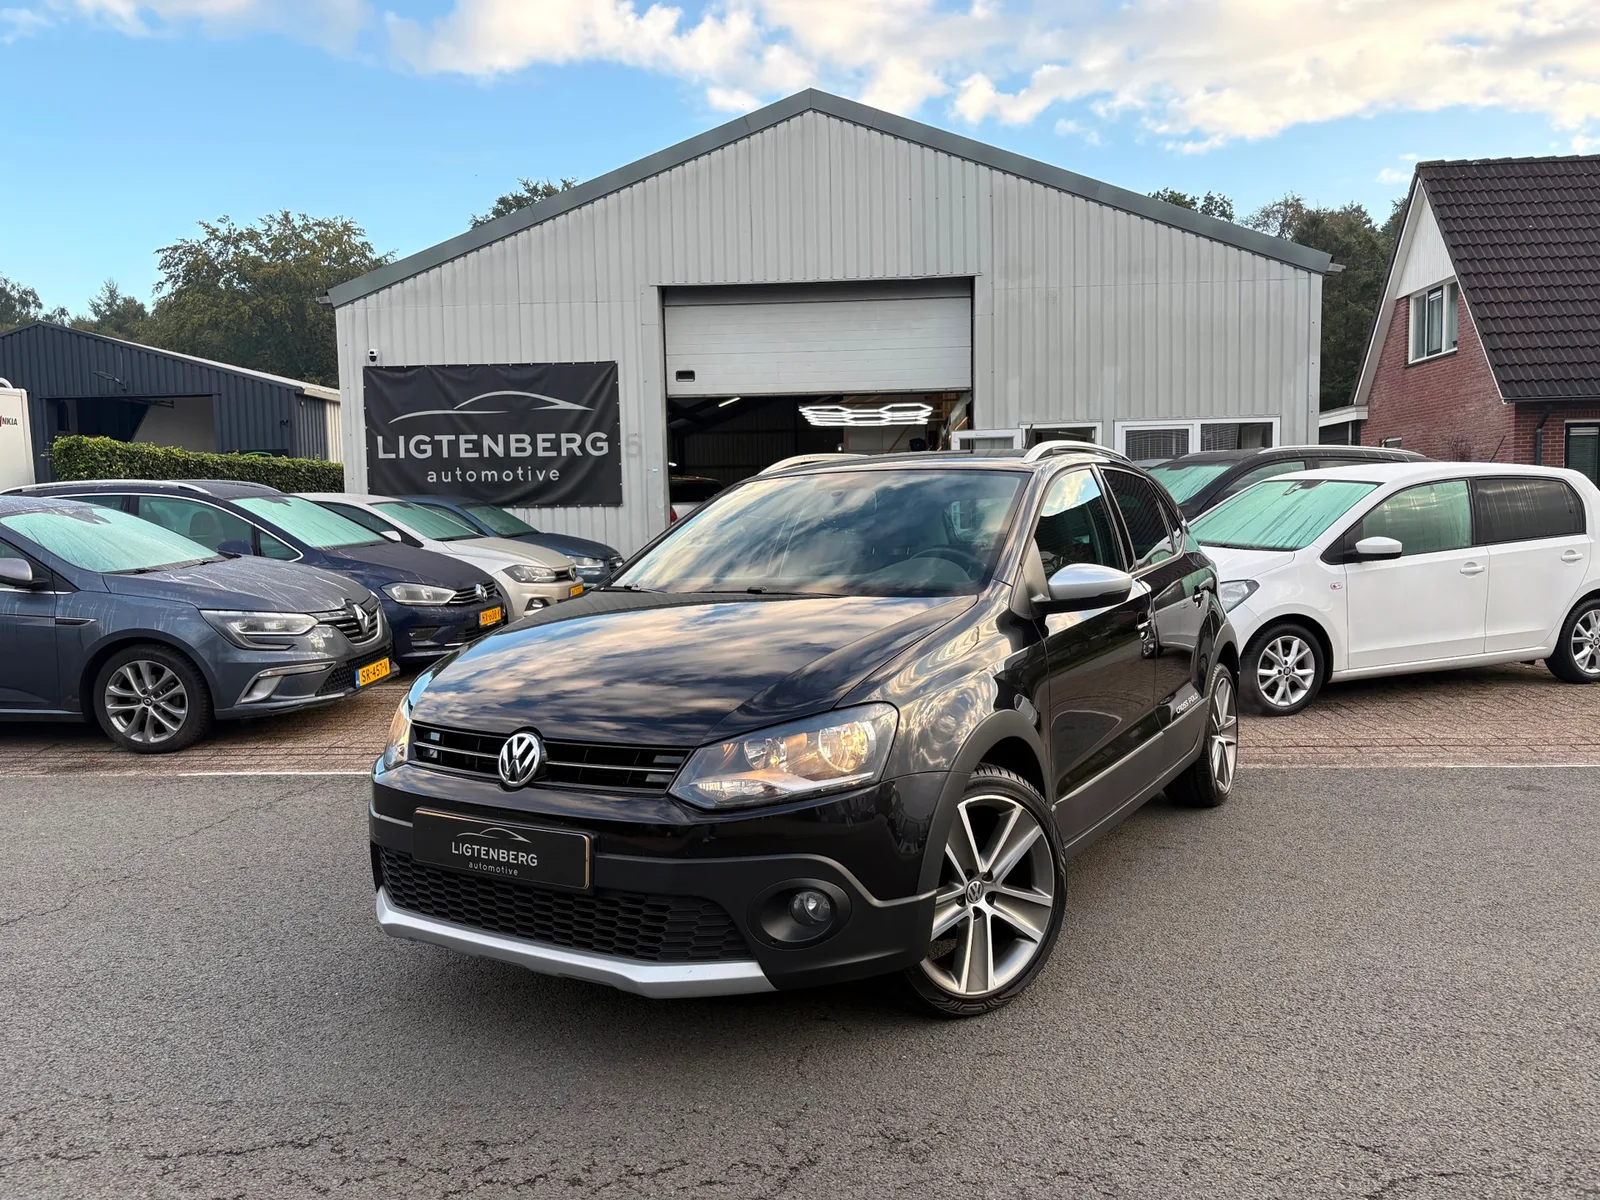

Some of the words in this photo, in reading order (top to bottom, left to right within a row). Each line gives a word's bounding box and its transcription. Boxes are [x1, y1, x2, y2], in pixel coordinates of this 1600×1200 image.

[377, 432, 609, 459] LIGTENBERG
[427, 466, 560, 483] automotive
[1175, 699, 1189, 714] CROSS
[1187, 692, 1199, 704] POLO
[499, 733, 540, 787] VW
[451, 841, 538, 867] LIGTENBERG
[468, 861, 519, 876] automotive
